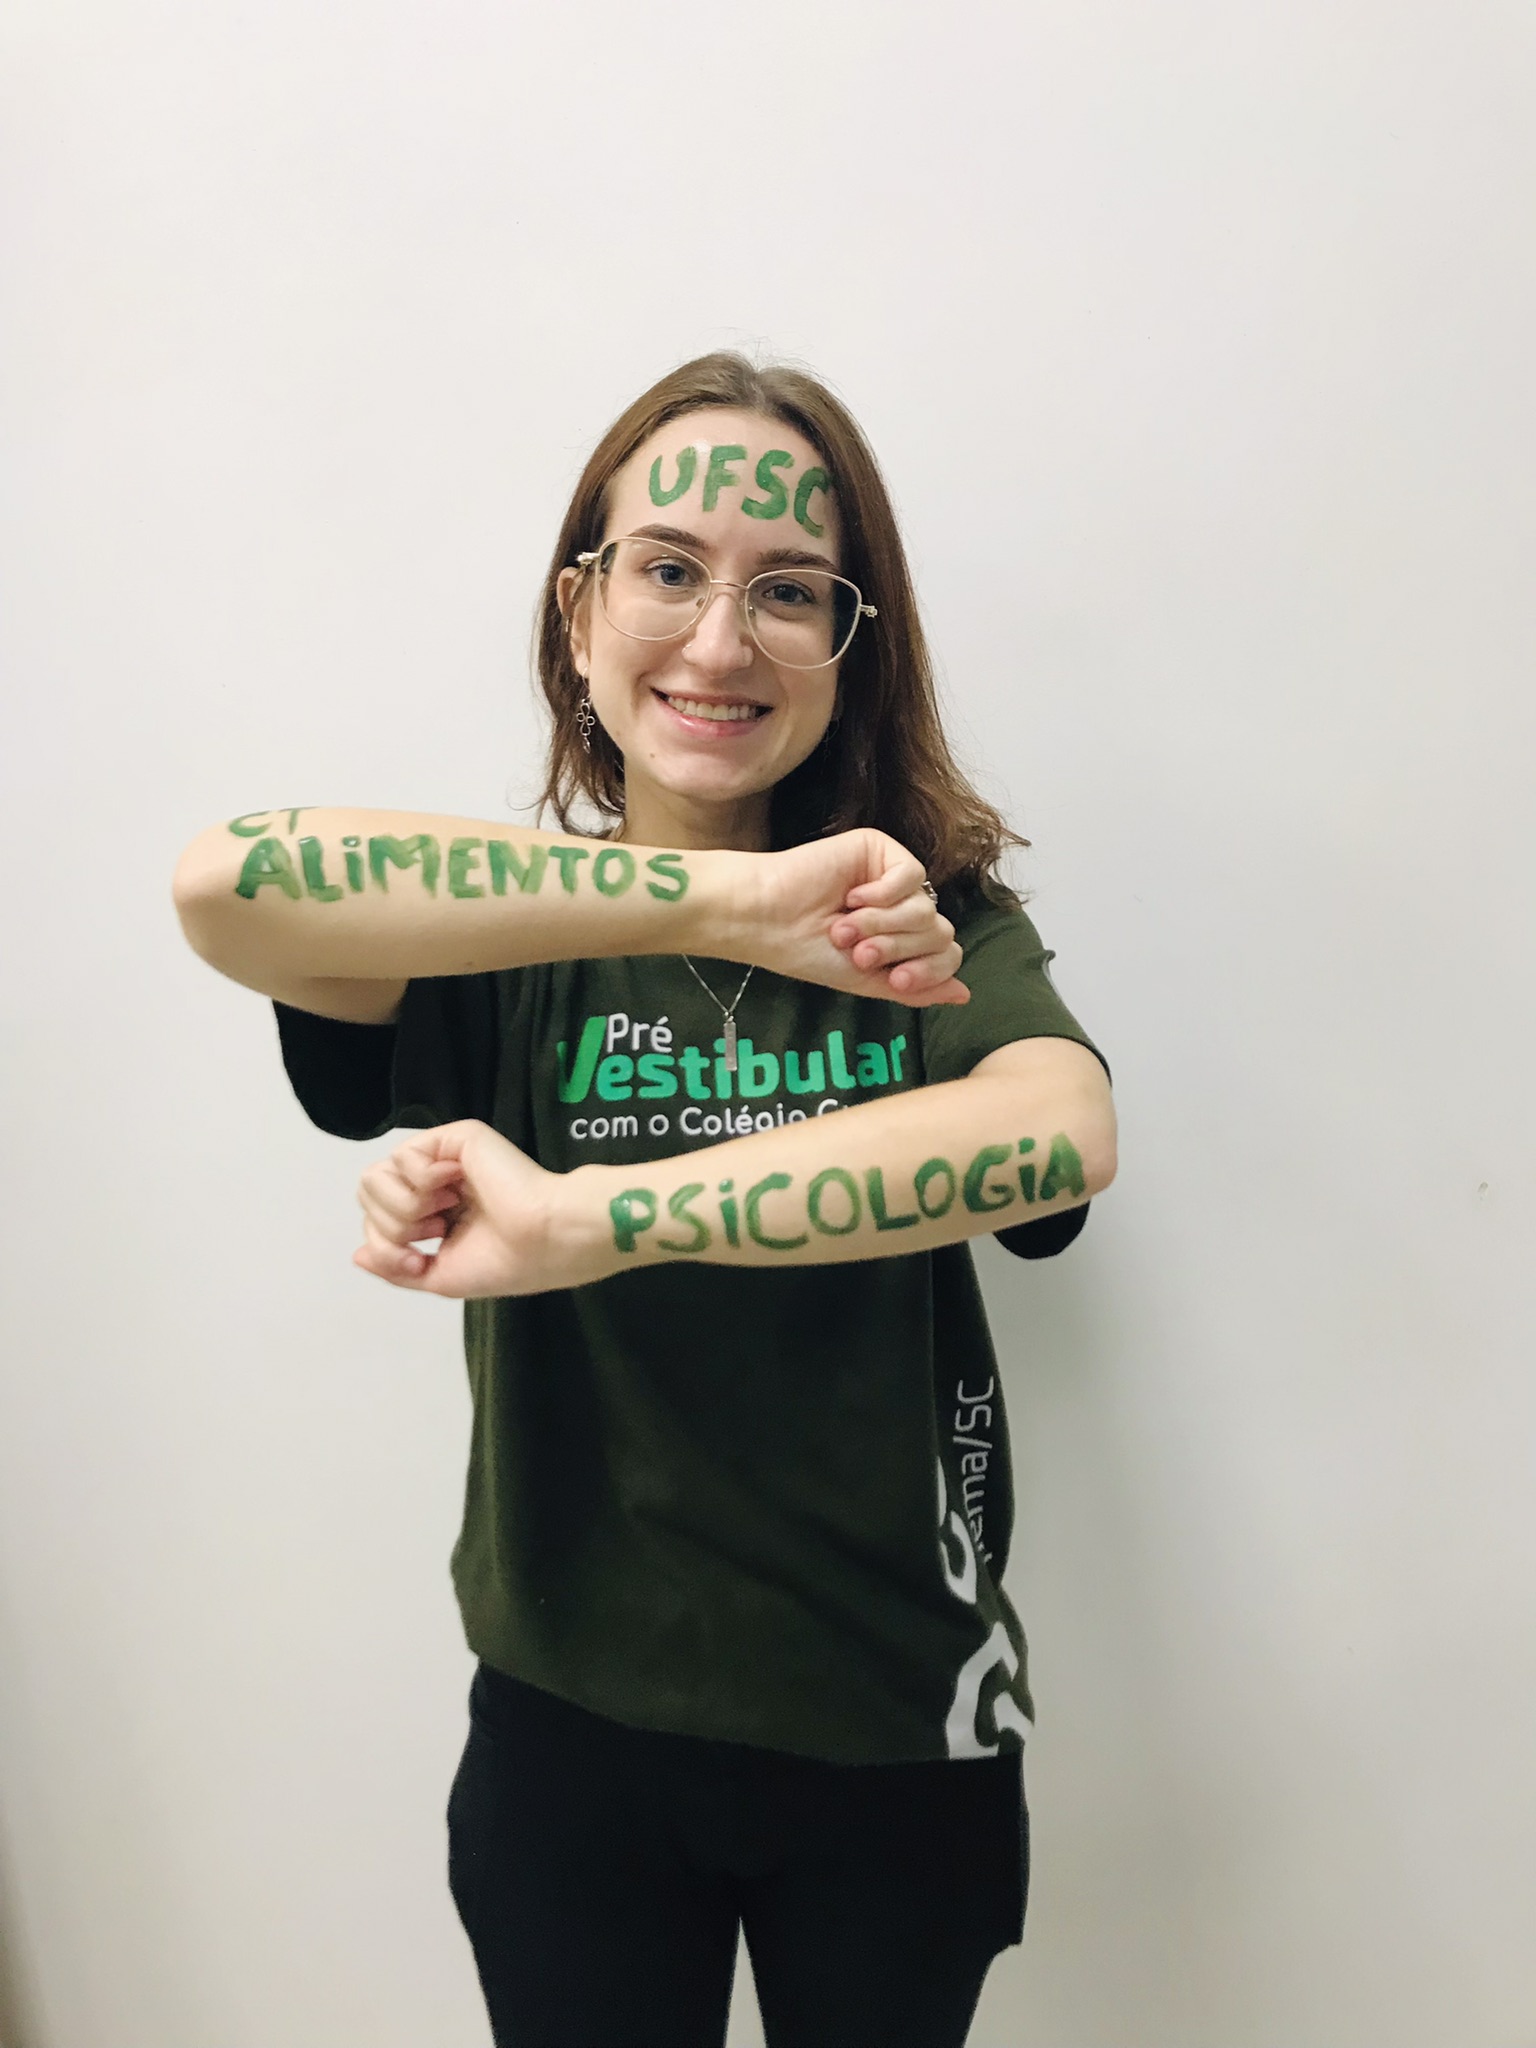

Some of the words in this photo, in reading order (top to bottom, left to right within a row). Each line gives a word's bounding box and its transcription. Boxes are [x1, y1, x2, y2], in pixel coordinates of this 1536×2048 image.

[649, 444, 833, 538] UFSC
[556, 1015, 906, 1103] Vestibular
[606, 1012, 673, 1054] Pré
[570, 1114, 638, 1140] com
[649, 1113, 669, 1136] o
